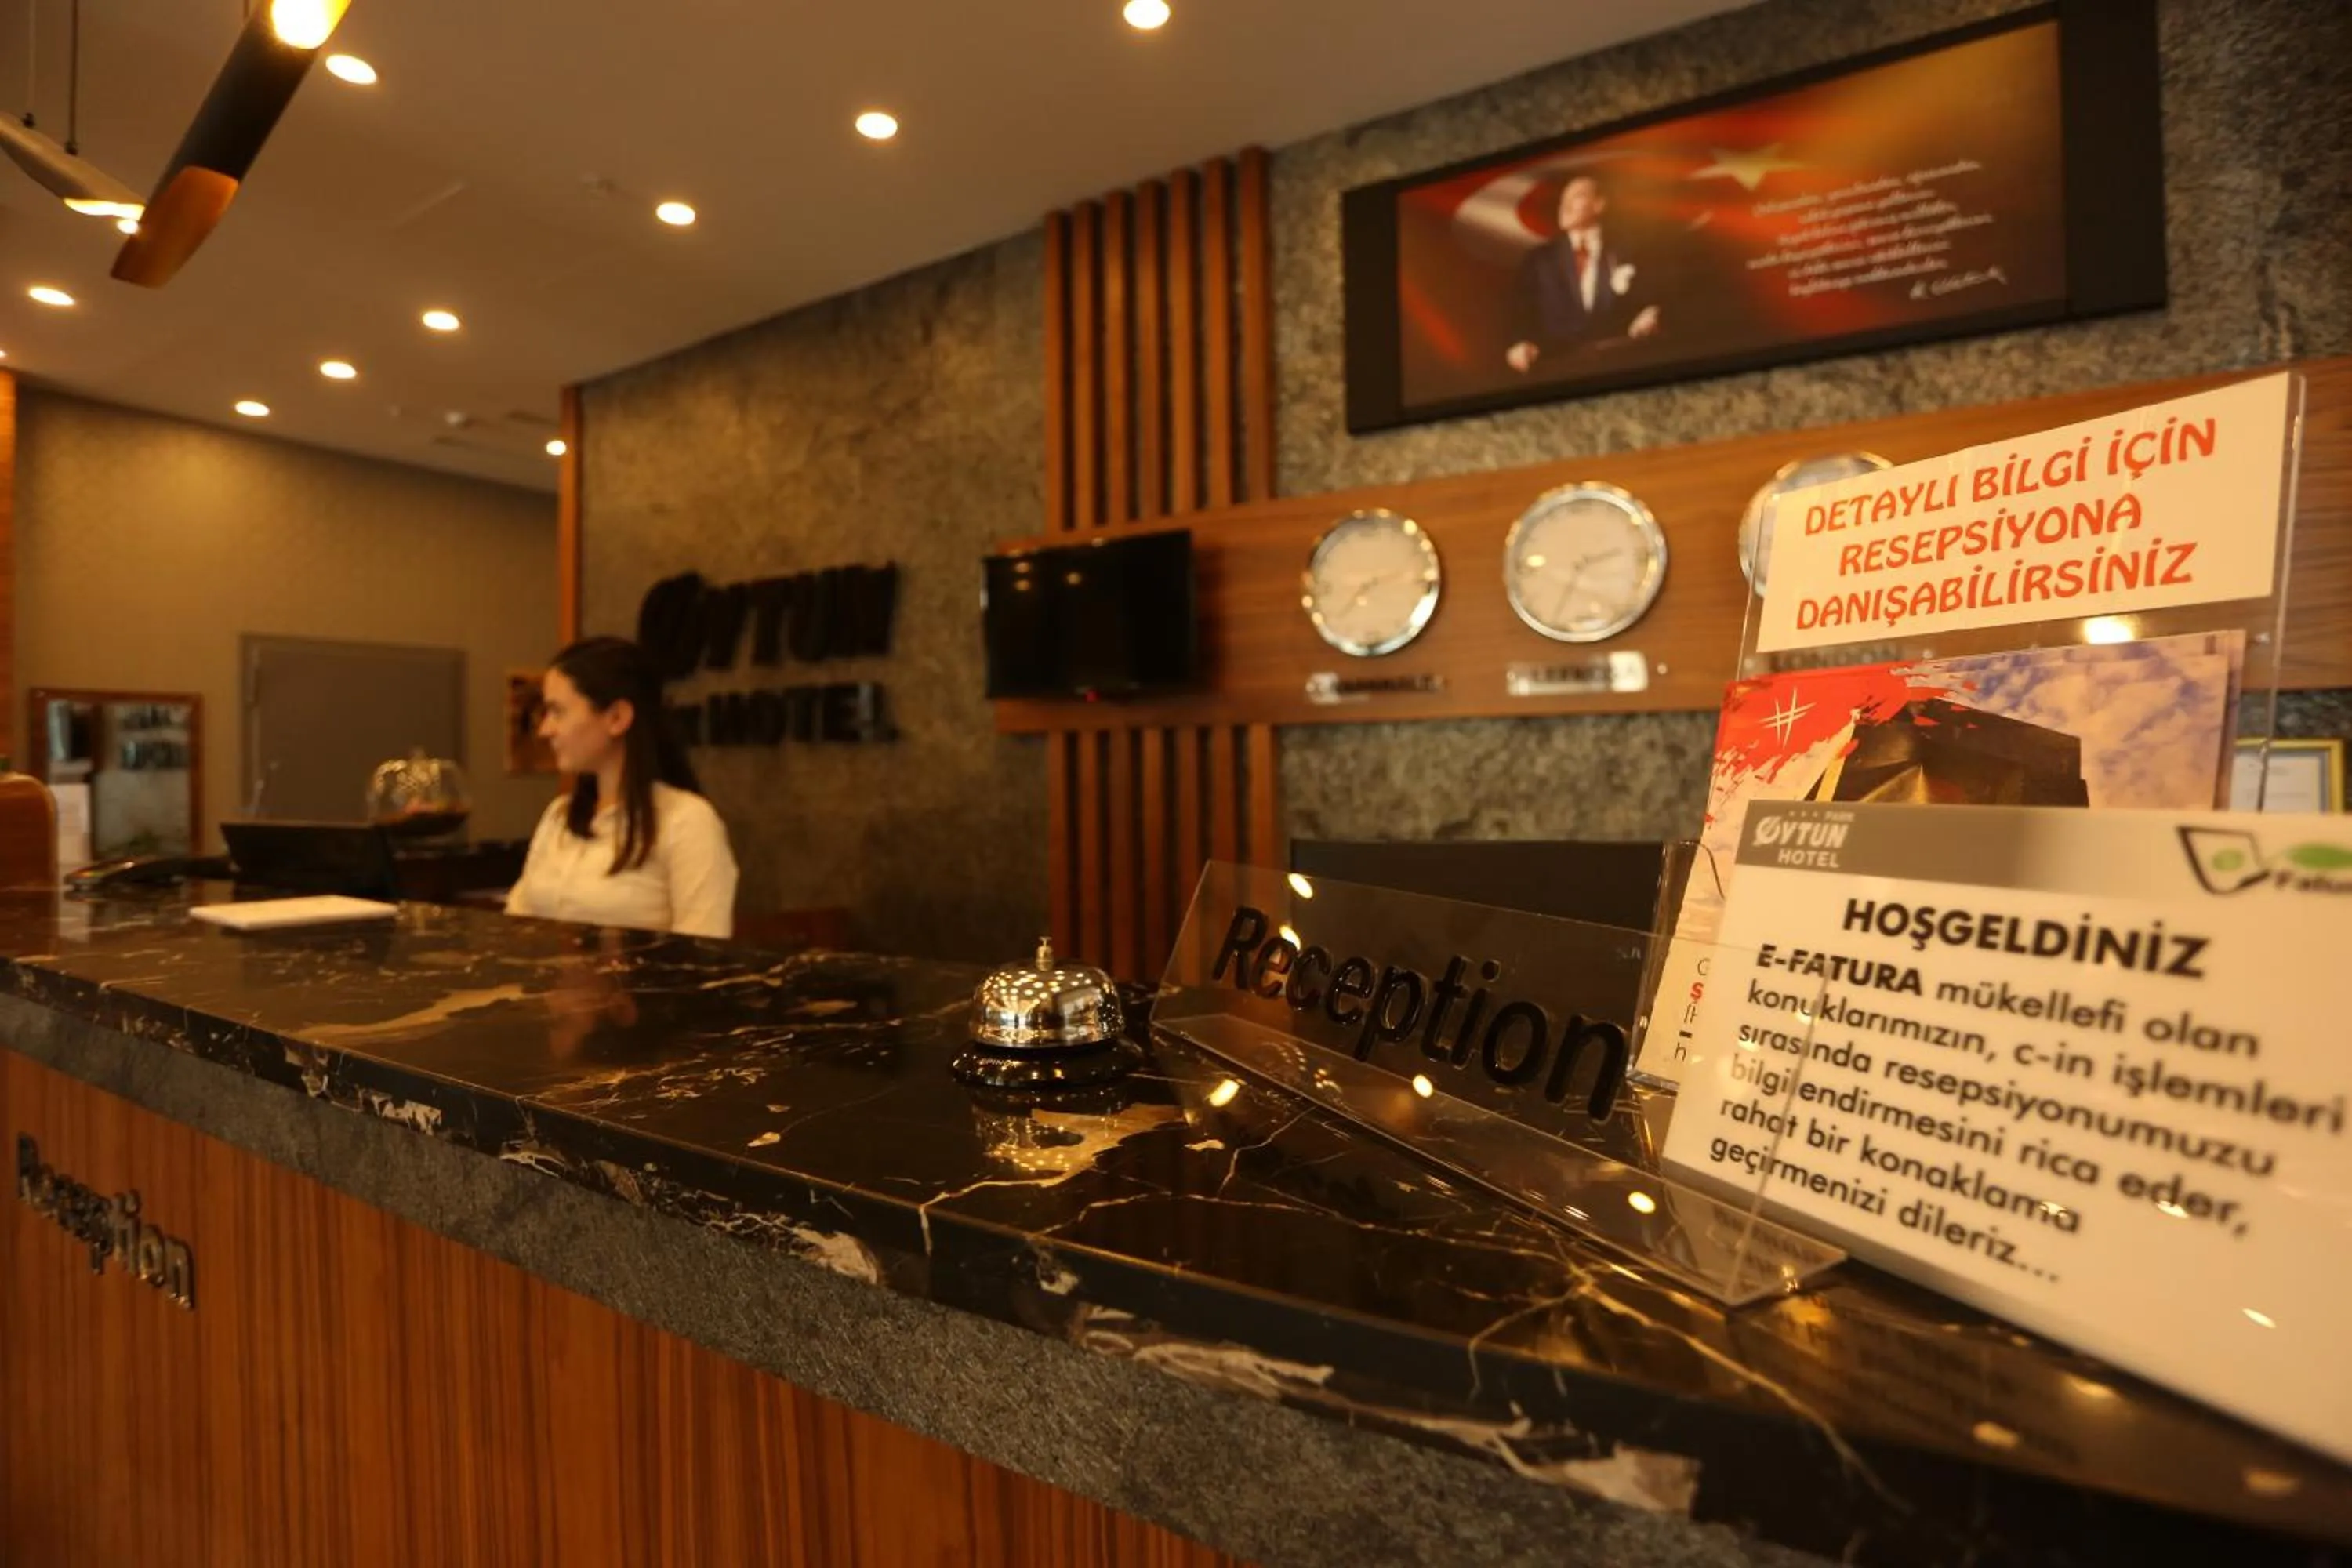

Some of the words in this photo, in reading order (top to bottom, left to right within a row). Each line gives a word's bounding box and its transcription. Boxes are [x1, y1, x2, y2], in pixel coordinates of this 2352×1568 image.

[1805, 474, 1958, 535] DETAYLI
[1972, 436, 2092, 503] BİLGİ
[2107, 416, 2217, 481] İÇİN
[1796, 537, 2198, 630] DANIŞABİLİRSİNİZ
[1839, 492, 2143, 577] RESEPSİYONA
[1777, 848, 1840, 869] HOTEL
[1842, 897, 2212, 980] HOŞGELDİNİZ
[1212, 906, 1629, 1123] Reception
[1746, 978, 1998, 1063] konuklarımızın,
[2012, 1040, 2095, 1079] c-in
[2111, 1052, 2344, 1135] işlemleri
[1755, 943, 1922, 996] E-FATURA
[1935, 980, 2126, 1033] mükellefi
[2142, 1011, 2261, 1058] olan
[1737, 1023, 1873, 1073] sırasında
[1883, 1058, 2276, 1177] resepsiyonumuzu
[1709, 1136, 1889, 1217] geçirmenizi
[1897, 1200, 2060, 1283] dileriz...
[1719, 1098, 1800, 1138] rahat
[1806, 1118, 1851, 1155] bir
[1859, 1134, 2081, 1236] konaklama
[2017, 1139, 2101, 1186] rica
[2118, 1173, 2249, 1238] eder,
